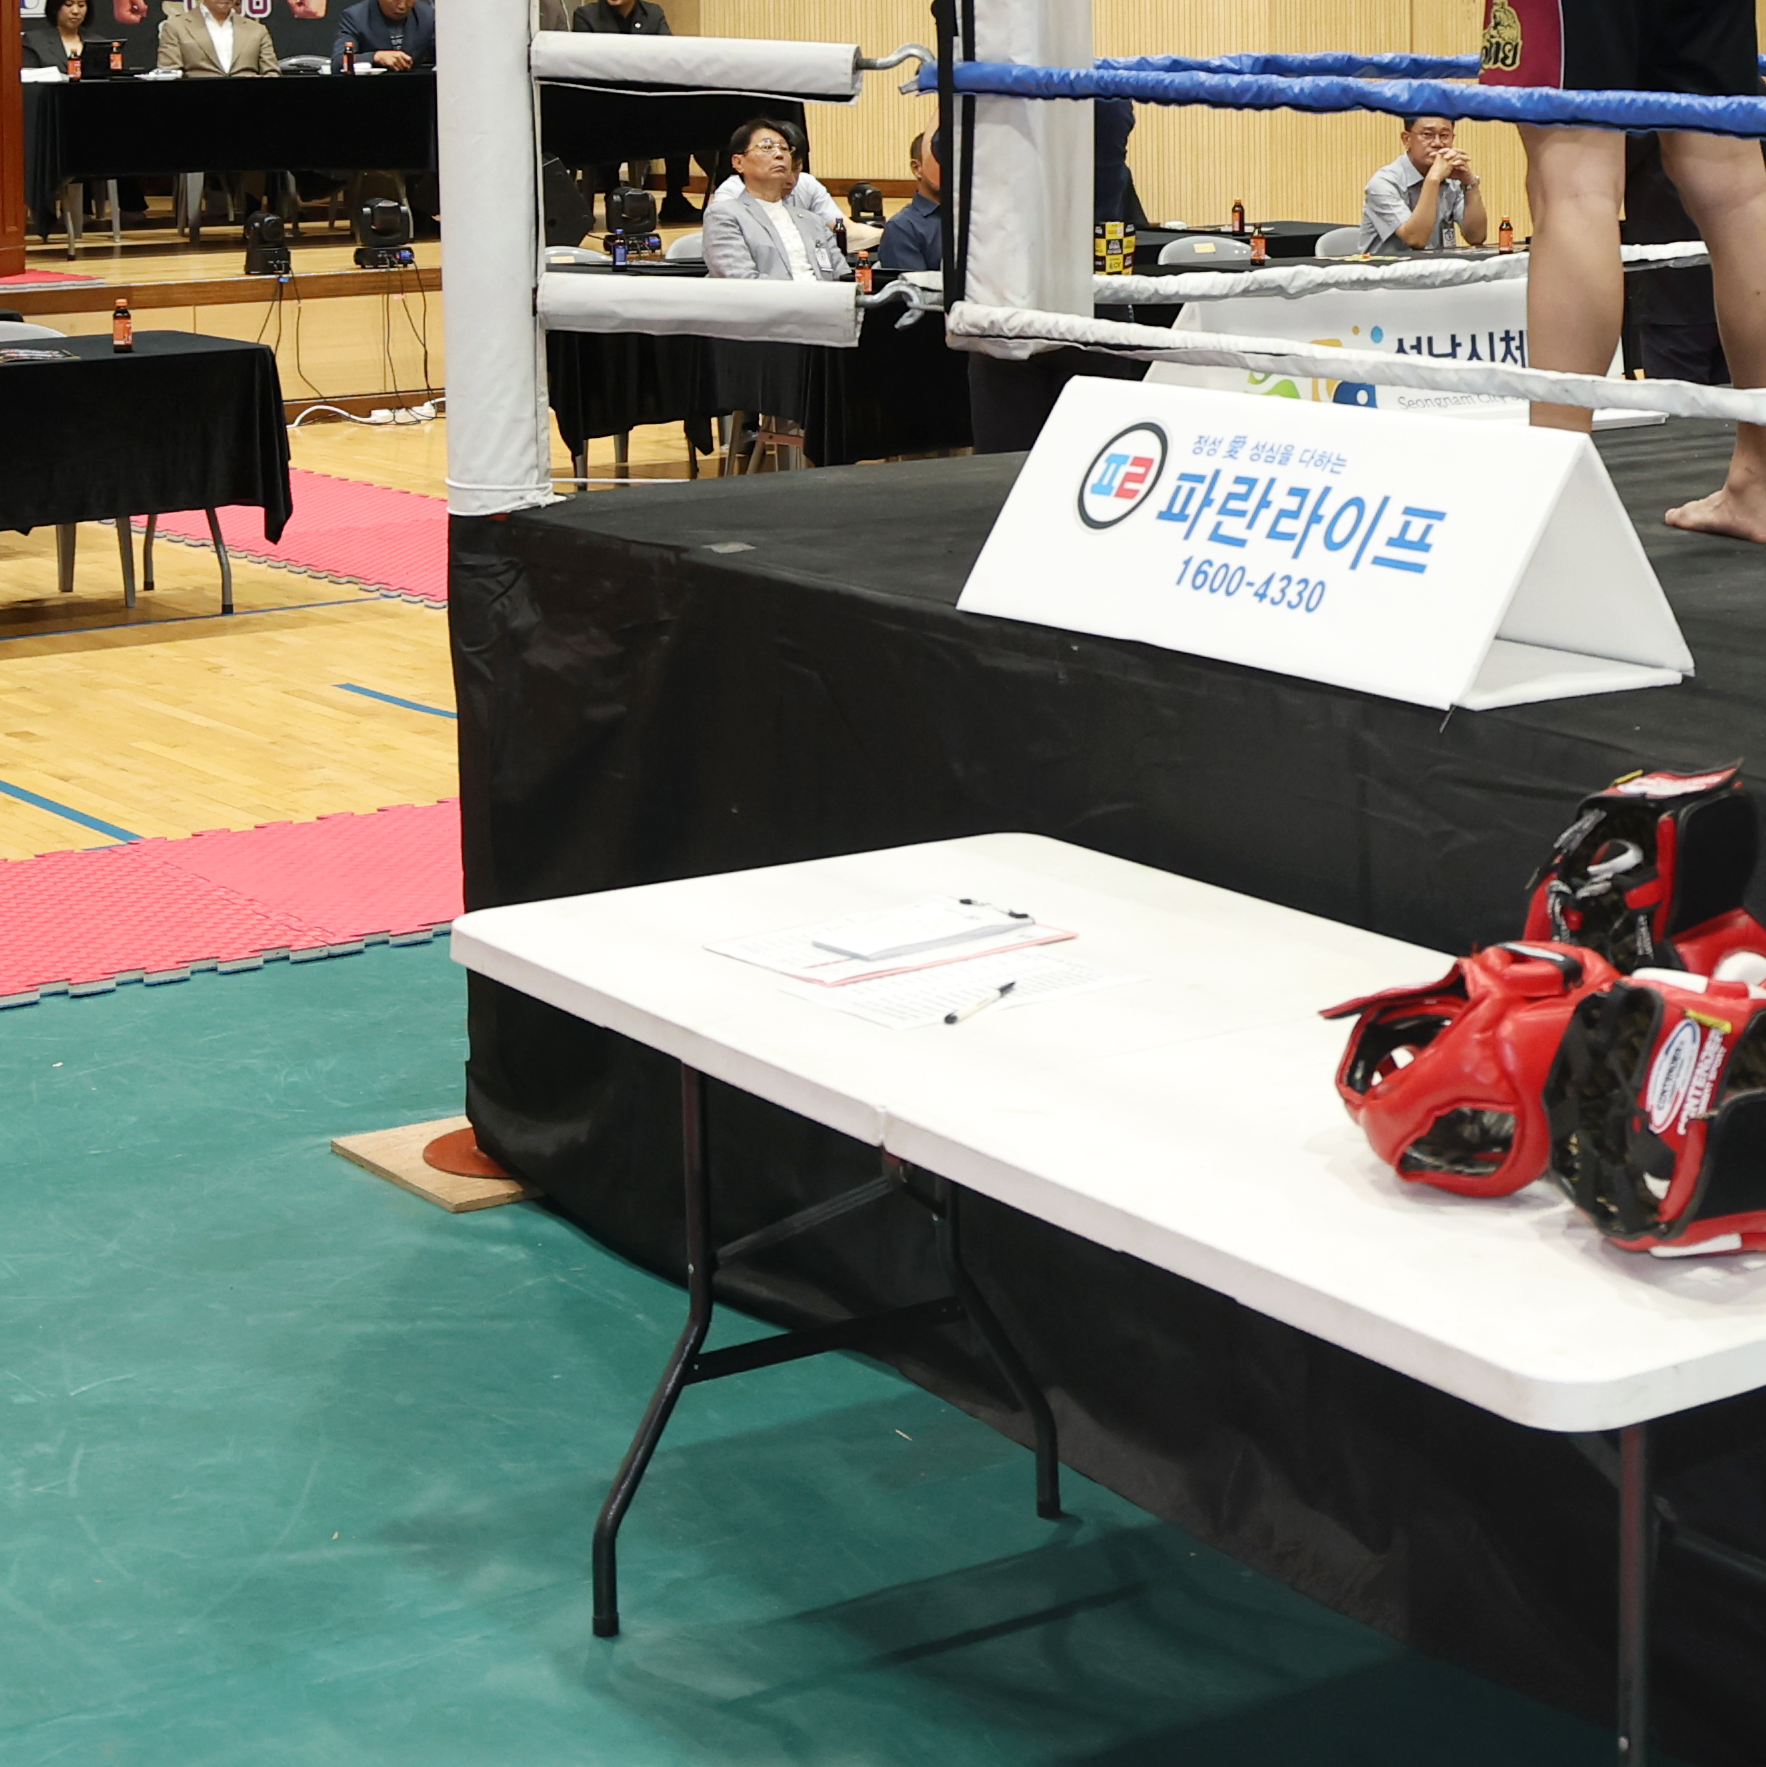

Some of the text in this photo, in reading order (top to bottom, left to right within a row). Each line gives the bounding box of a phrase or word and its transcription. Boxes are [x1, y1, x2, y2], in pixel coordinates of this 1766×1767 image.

[1193, 435, 1224, 457] 정성
[1250, 439, 1295, 466] 성심을
[1299, 447, 1347, 475] 다하는
[1156, 468, 1447, 574] 파란라이프
[1176, 556, 1326, 613] 1600-4330
